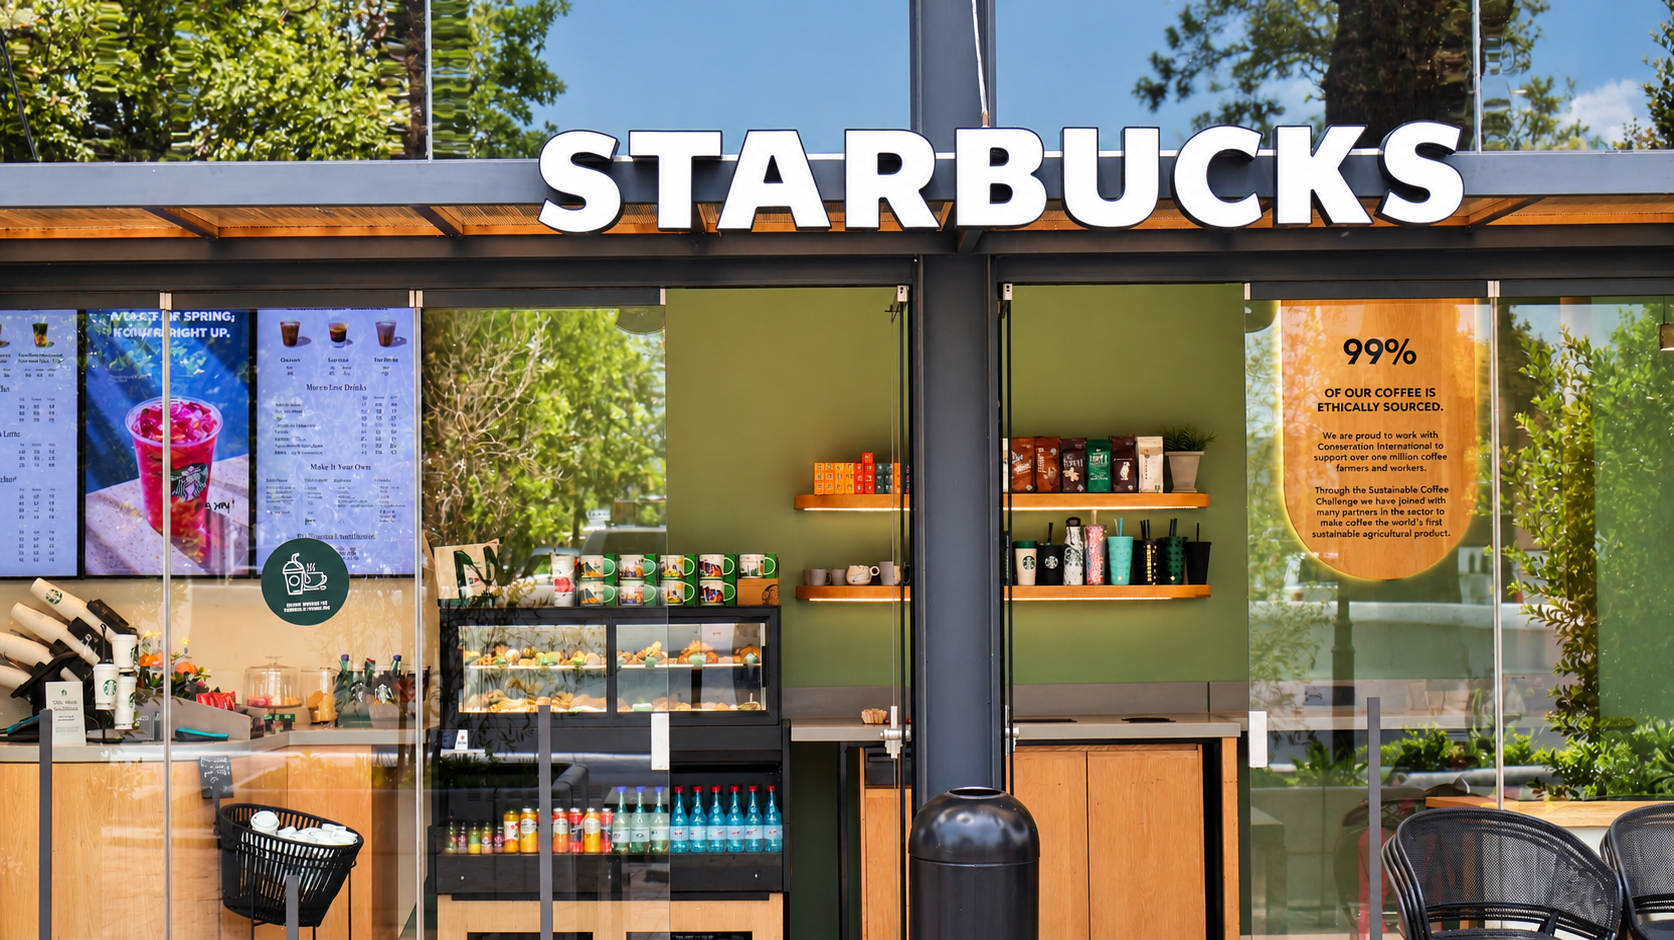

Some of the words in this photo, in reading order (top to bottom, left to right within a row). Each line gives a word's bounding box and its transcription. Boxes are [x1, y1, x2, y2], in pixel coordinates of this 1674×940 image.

[538, 121, 1465, 233] STARBUCKS
[210, 328, 231, 338] UP.
[1343, 338, 1417, 365] 99%
[1325, 388, 1341, 398] OF
[1345, 388, 1371, 398] OUR
[1375, 388, 1421, 398] COFFEE
[1426, 388, 1436, 397] IS
[1318, 402, 1380, 412] ETHICALLY
[1383, 402, 1443, 411] SOURCED.
[1323, 432, 1336, 440] We
[1356, 431, 1381, 443] proud
[1396, 431, 1417, 439] work
[1420, 431, 1438, 439] with
[1377, 442, 1432, 450] International
[1314, 454, 1347, 463] support
[1421, 452, 1447, 460] coffee
[1336, 464, 1369, 472] farmers
[1372, 464, 1387, 472] and
[1390, 464, 1426, 472] workers.
[1315, 486, 1350, 496] Through
[1353, 486, 1366, 494] the
[1369, 486, 1418, 494] Sustainable
[1420, 485, 1449, 494] Coffee
[1376, 497, 1396, 505] have
[1399, 497, 1425, 507] joined
[1428, 496, 1446, 504] with
[1317, 510, 1340, 518] many
[1342, 509, 1377, 517] partners
[1391, 508, 1404, 516] the
[1436, 508, 1445, 516] to
[1321, 519, 1343, 527] make
[1346, 518, 1372, 526] coffee
[1375, 518, 1389, 526] the
[1392, 518, 1423, 526] world's
[1426, 518, 1442, 526] first
[1312, 530, 1360, 538] sustainable
[1363, 529, 1412, 540] agricultural
[1414, 529, 1450, 539] product.
